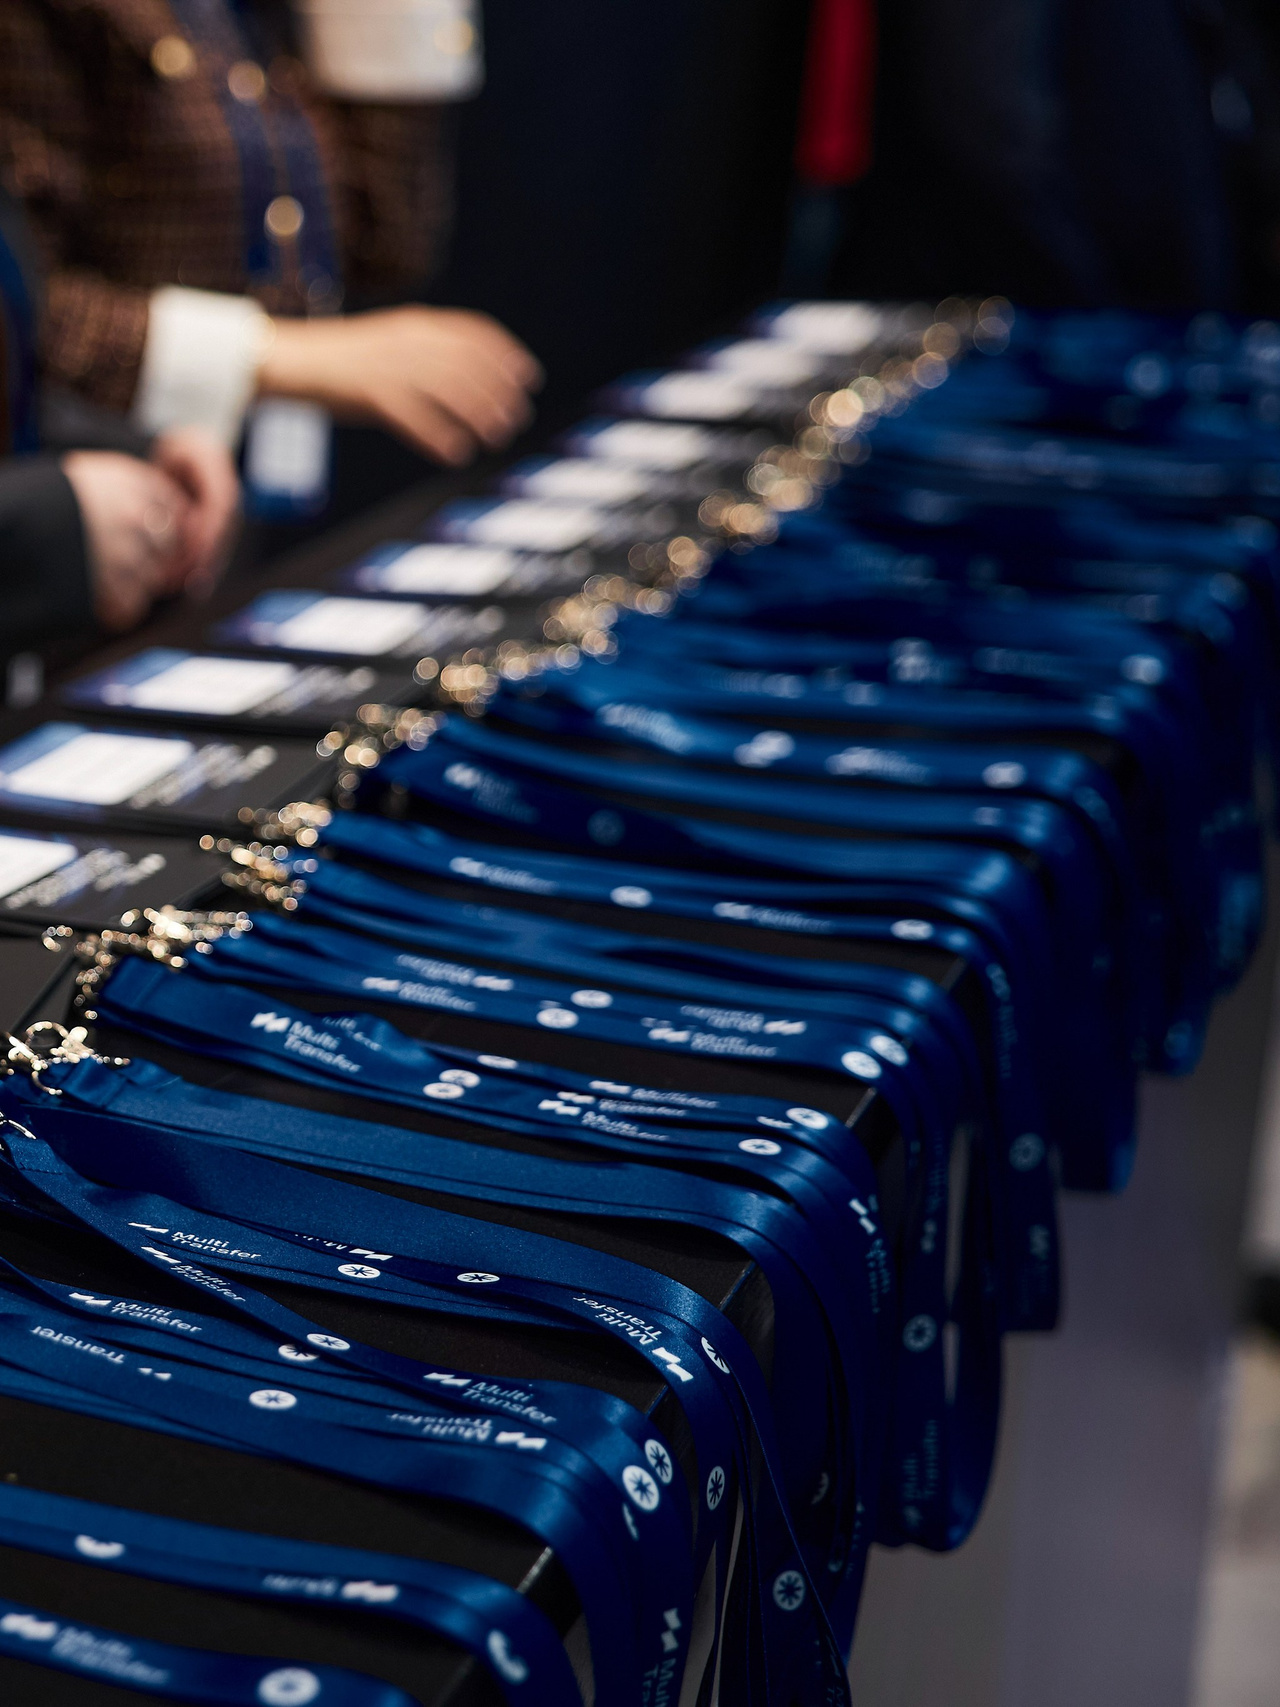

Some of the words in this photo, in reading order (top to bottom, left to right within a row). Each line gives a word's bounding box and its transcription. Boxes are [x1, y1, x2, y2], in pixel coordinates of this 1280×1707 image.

[171, 1235, 261, 1260] Transfer
[174, 1231, 229, 1248] Multi
[170, 1265, 246, 1302] Transfer
[177, 1265, 232, 1287] Multi
[110, 1305, 202, 1333] Transfer
[113, 1301, 173, 1317] Multi
[572, 1296, 662, 1341] Transfer
[595, 1312, 654, 1345] Multi
[30, 1325, 125, 1365] Transfer
[472, 1381, 534, 1402] Multi
[462, 1388, 557, 1424] Transfer
